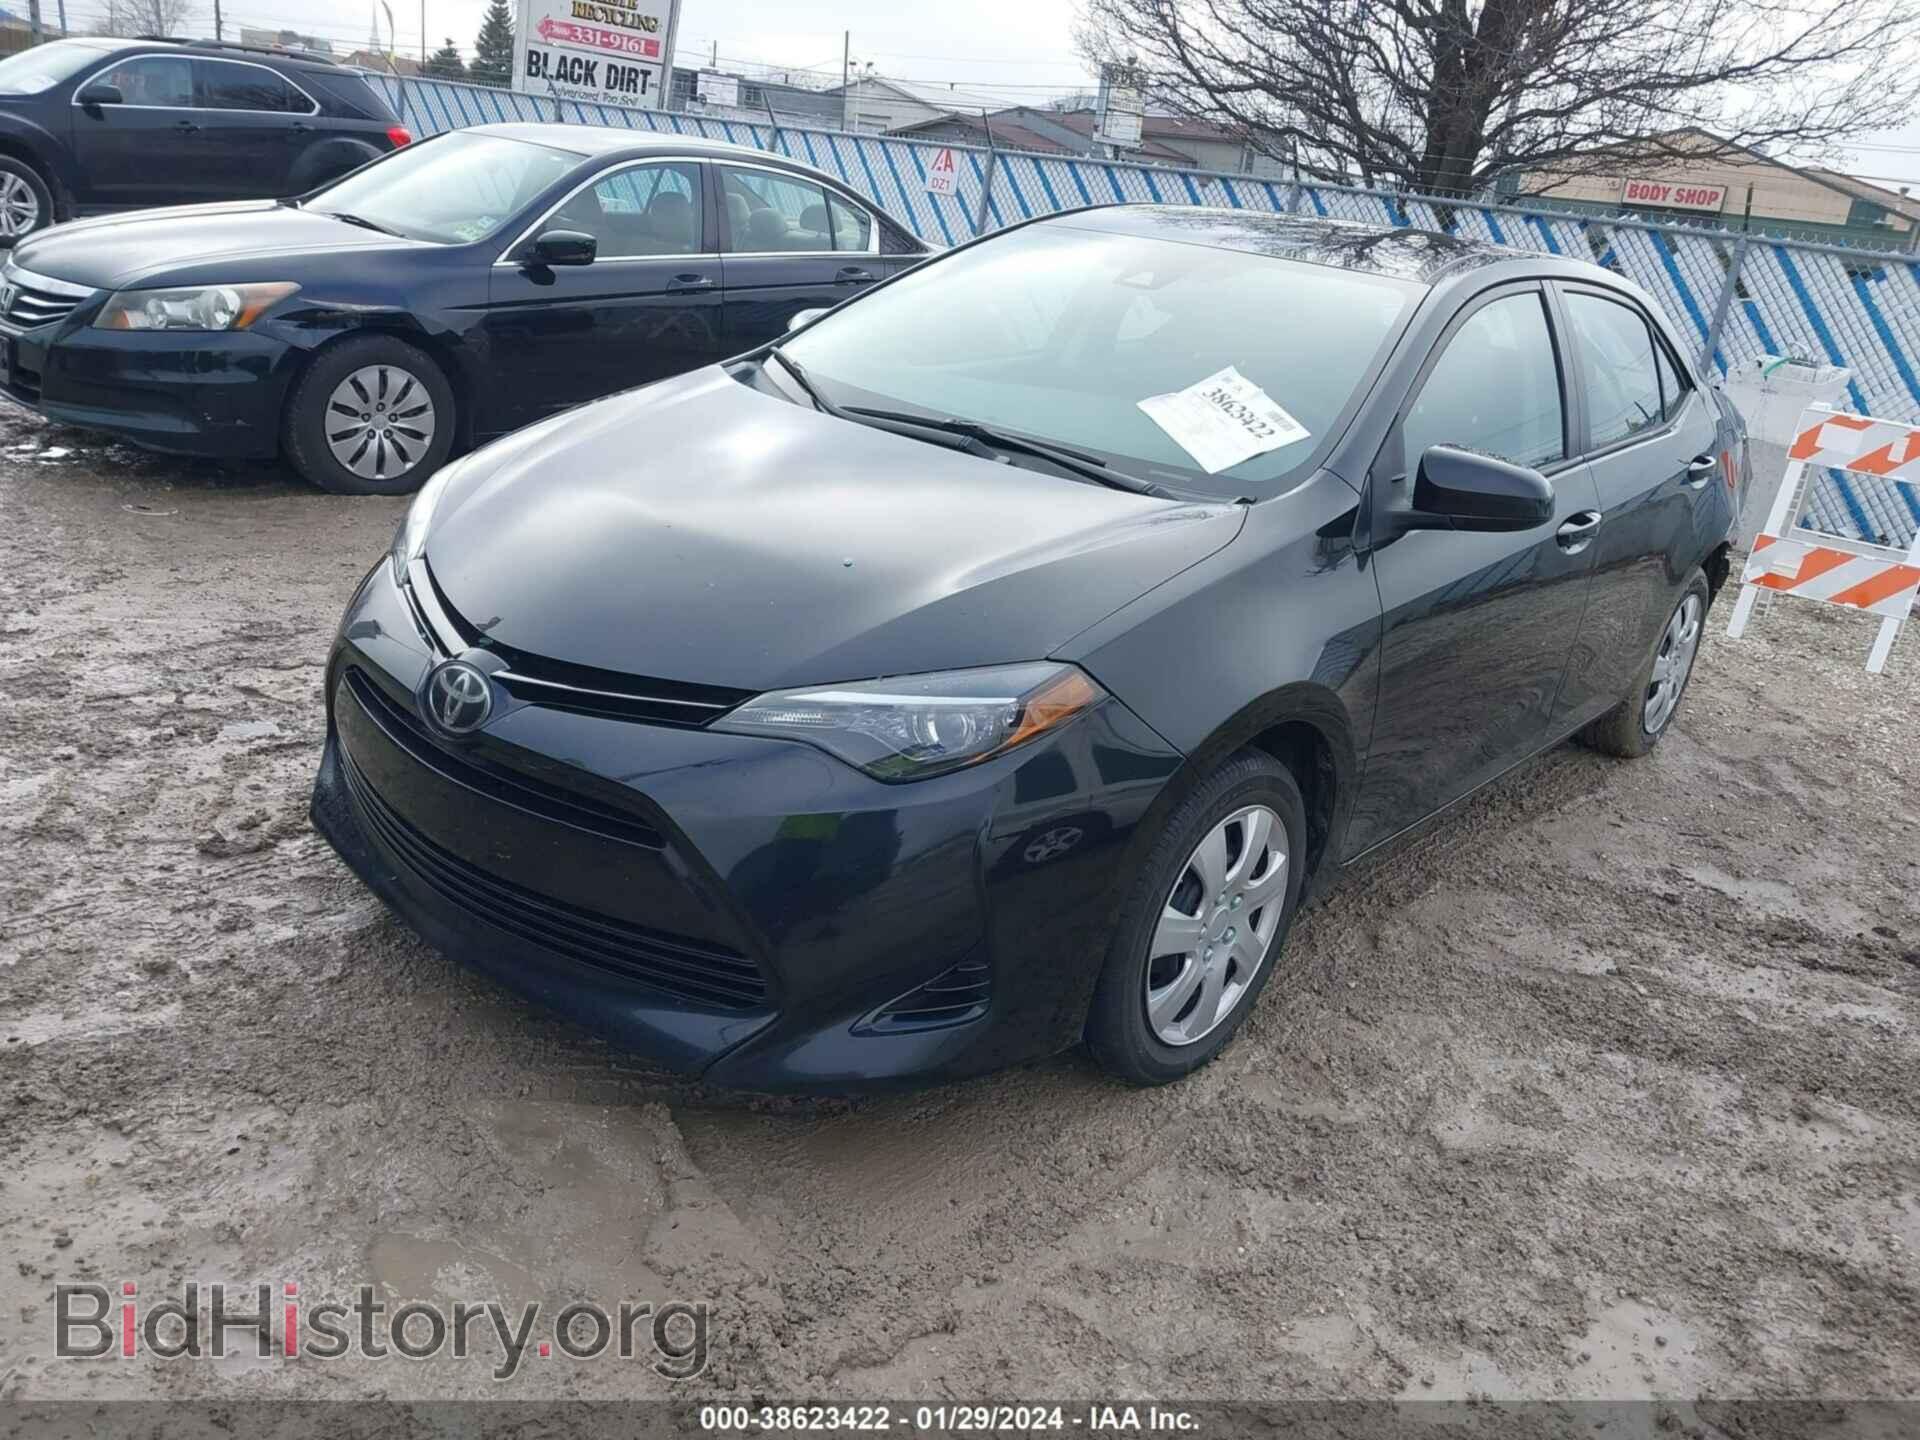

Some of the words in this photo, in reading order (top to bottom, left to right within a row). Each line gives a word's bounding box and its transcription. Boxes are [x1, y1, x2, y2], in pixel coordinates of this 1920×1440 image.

[572, 1, 658, 33] RECYCLING
[571, 26, 646, 53] 331-9161
[527, 49, 599, 88] BLACK
[605, 63, 652, 95] DIRT
[1628, 183, 1672, 201] BODY
[1674, 188, 1720, 206] SHOP
[1202, 387, 1276, 439] 38623422
